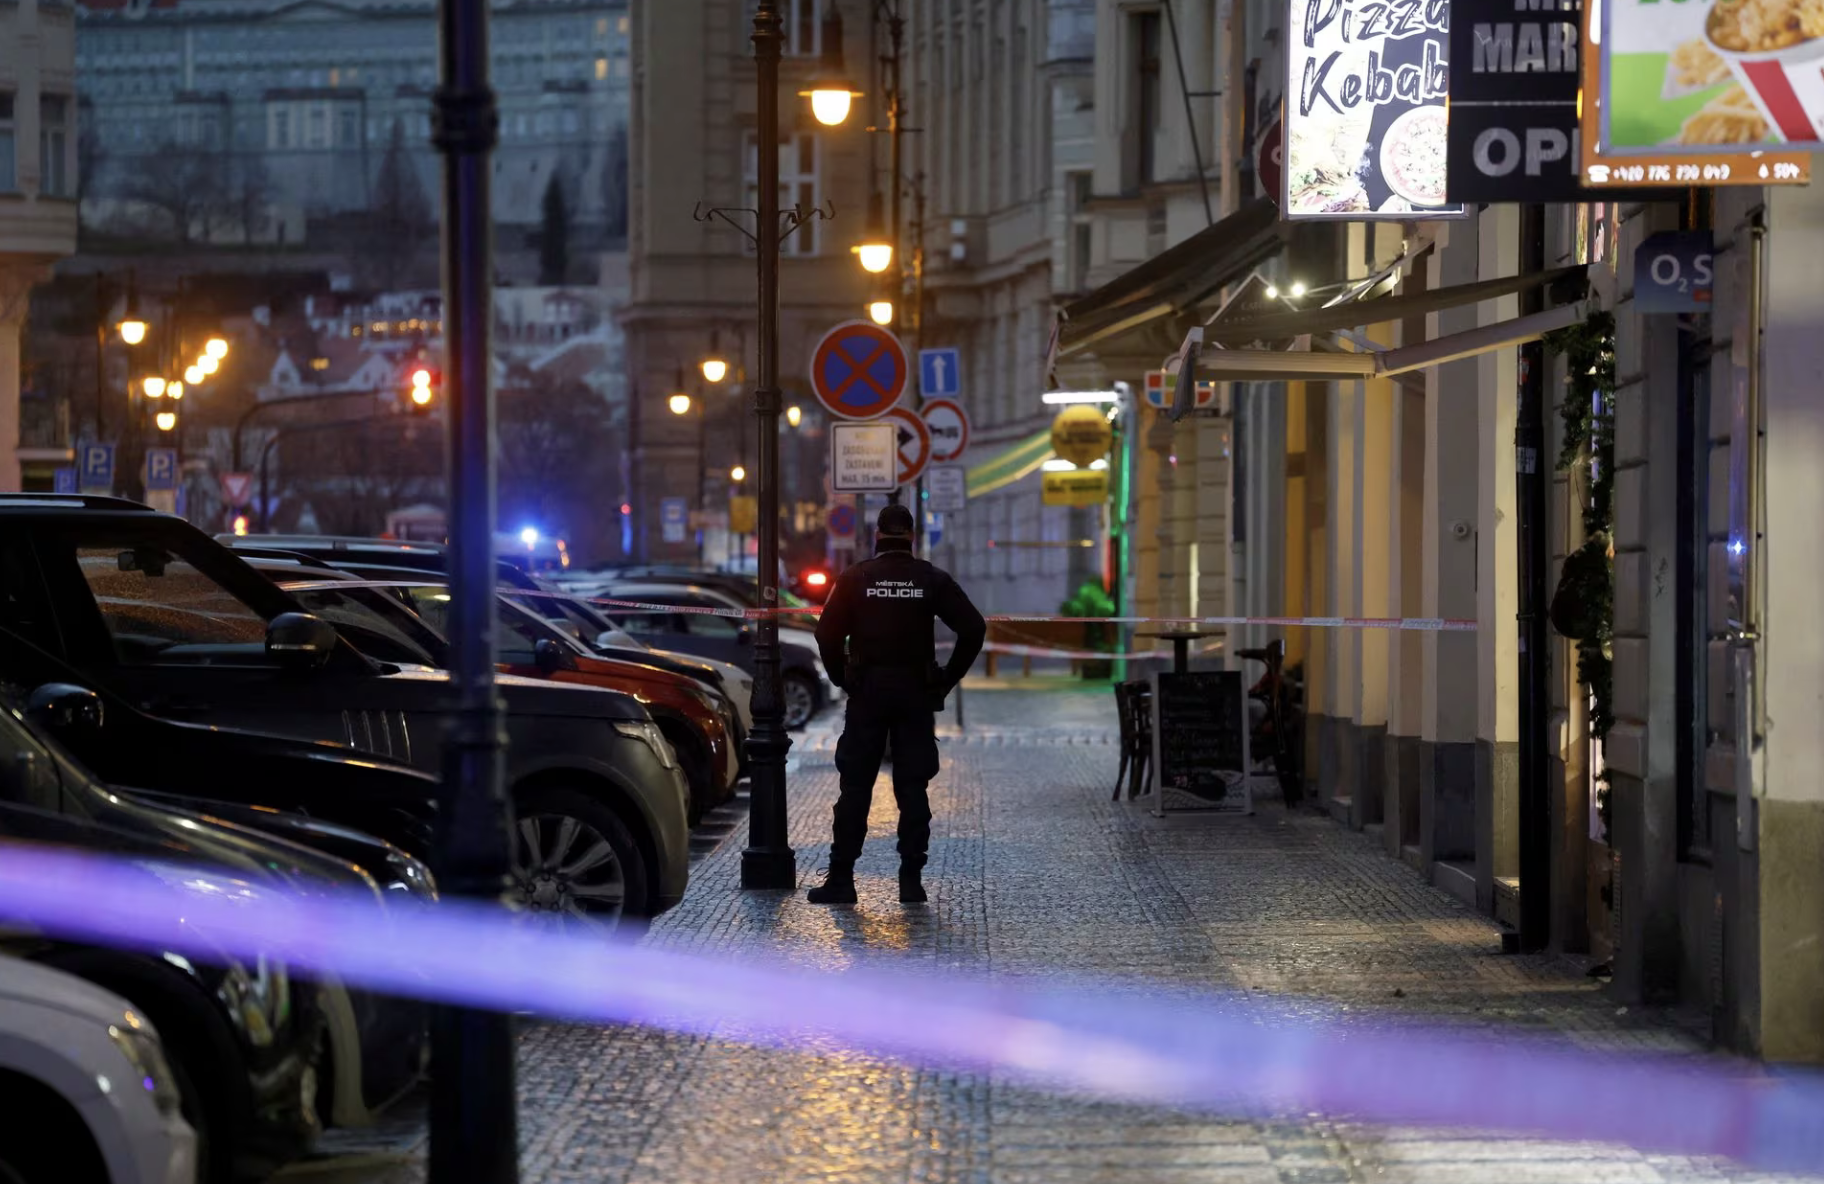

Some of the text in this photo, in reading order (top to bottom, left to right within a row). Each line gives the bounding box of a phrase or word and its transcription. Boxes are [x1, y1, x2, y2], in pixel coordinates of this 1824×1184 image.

[1304, 0, 1449, 48] Pizza
[1300, 42, 1449, 117] Kebab
[88, 447, 107, 474] P
[152, 454, 170, 479] P
[866, 588, 924, 598] POLICIE
